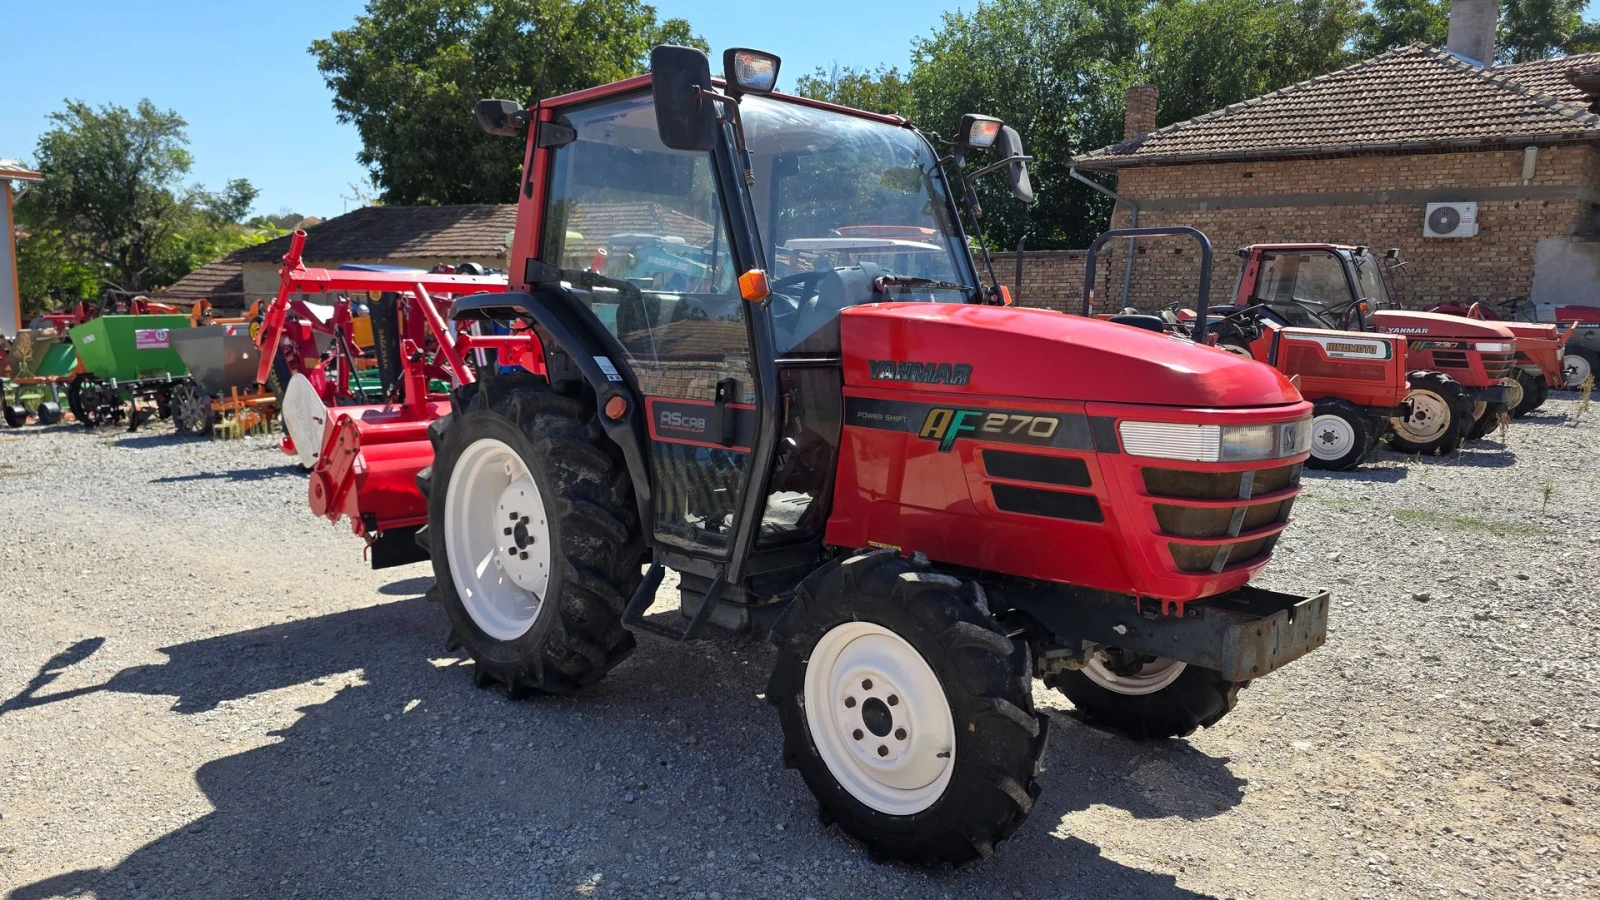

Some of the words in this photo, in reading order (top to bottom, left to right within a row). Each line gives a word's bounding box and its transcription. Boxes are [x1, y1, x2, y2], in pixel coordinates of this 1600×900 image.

[1326, 343, 1377, 354] HINOMOTO
[868, 360, 972, 386] YANMAR
[857, 411, 883, 421] POWER
[885, 414, 907, 423] SHIFT
